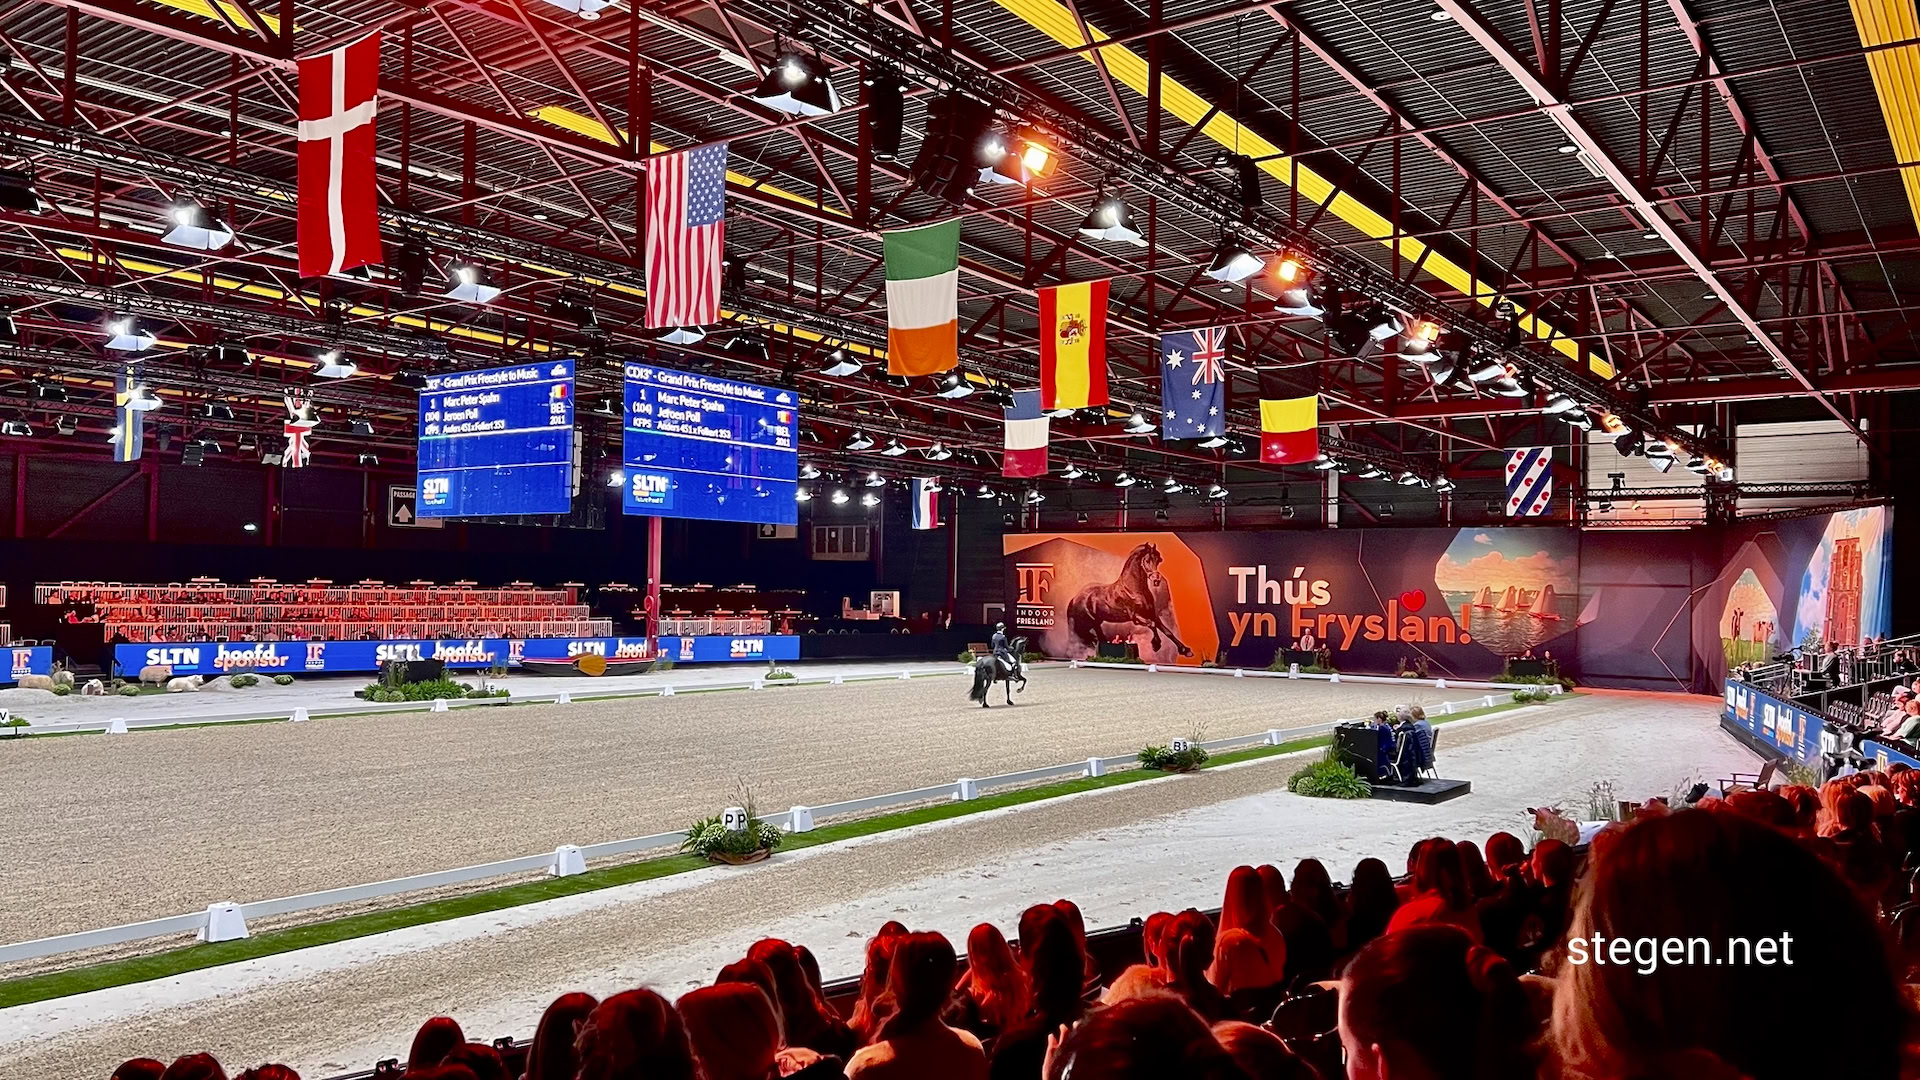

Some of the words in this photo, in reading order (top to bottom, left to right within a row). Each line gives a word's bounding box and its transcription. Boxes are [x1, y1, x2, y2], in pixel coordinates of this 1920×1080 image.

[444, 376, 464, 388] Grand
[464, 374, 478, 386] Prix
[478, 372, 508, 384] Freestyle
[509, 370, 516, 380] to
[517, 368, 538, 380] Music
[658, 371, 682, 386] Grand
[684, 376, 699, 388] Prix
[700, 379, 732, 396] Freestyle
[734, 386, 742, 396] to
[743, 386, 764, 400] Music
[430, 398, 436, 409] 1
[443, 396, 460, 408] Marc
[461, 394, 478, 406] Peter
[480, 392, 500, 406] Spahn
[551, 402, 566, 414] BEL
[640, 389, 646, 400] 1
[658, 392, 678, 405] Marc
[680, 396, 700, 408] Peter
[702, 398, 725, 412] Spahn
[443, 410, 464, 422] Jeroen
[465, 408, 478, 420] Poll
[550, 414, 566, 425] 2011
[632, 402, 652, 415] (104)
[658, 407, 684, 421] Jeroen
[686, 411, 700, 422] Poll
[633, 416, 652, 428] KFPS
[657, 422, 680, 432] Anders
[719, 429, 731, 439] 353
[776, 426, 790, 438] BEL
[776, 437, 790, 448] 2011
[423, 478, 448, 494] SLTN
[632, 474, 666, 492] SLTN
[1016, 568, 1055, 604] IF
[1228, 564, 1331, 606] Thús
[1017, 618, 1054, 626] FRIESLAND
[1228, 612, 1277, 647] yn
[146, 648, 200, 665] SLTN
[218, 644, 276, 660] hoofd
[306, 644, 325, 660] IF
[435, 640, 483, 657] hoofd
[509, 641, 525, 658] IF
[730, 639, 764, 653] SLTN
[12, 650, 32, 668] IF
[214, 655, 290, 672] sponsor
[1174, 742, 1181, 751] B
[725, 814, 734, 826] P
[738, 814, 746, 828] P
